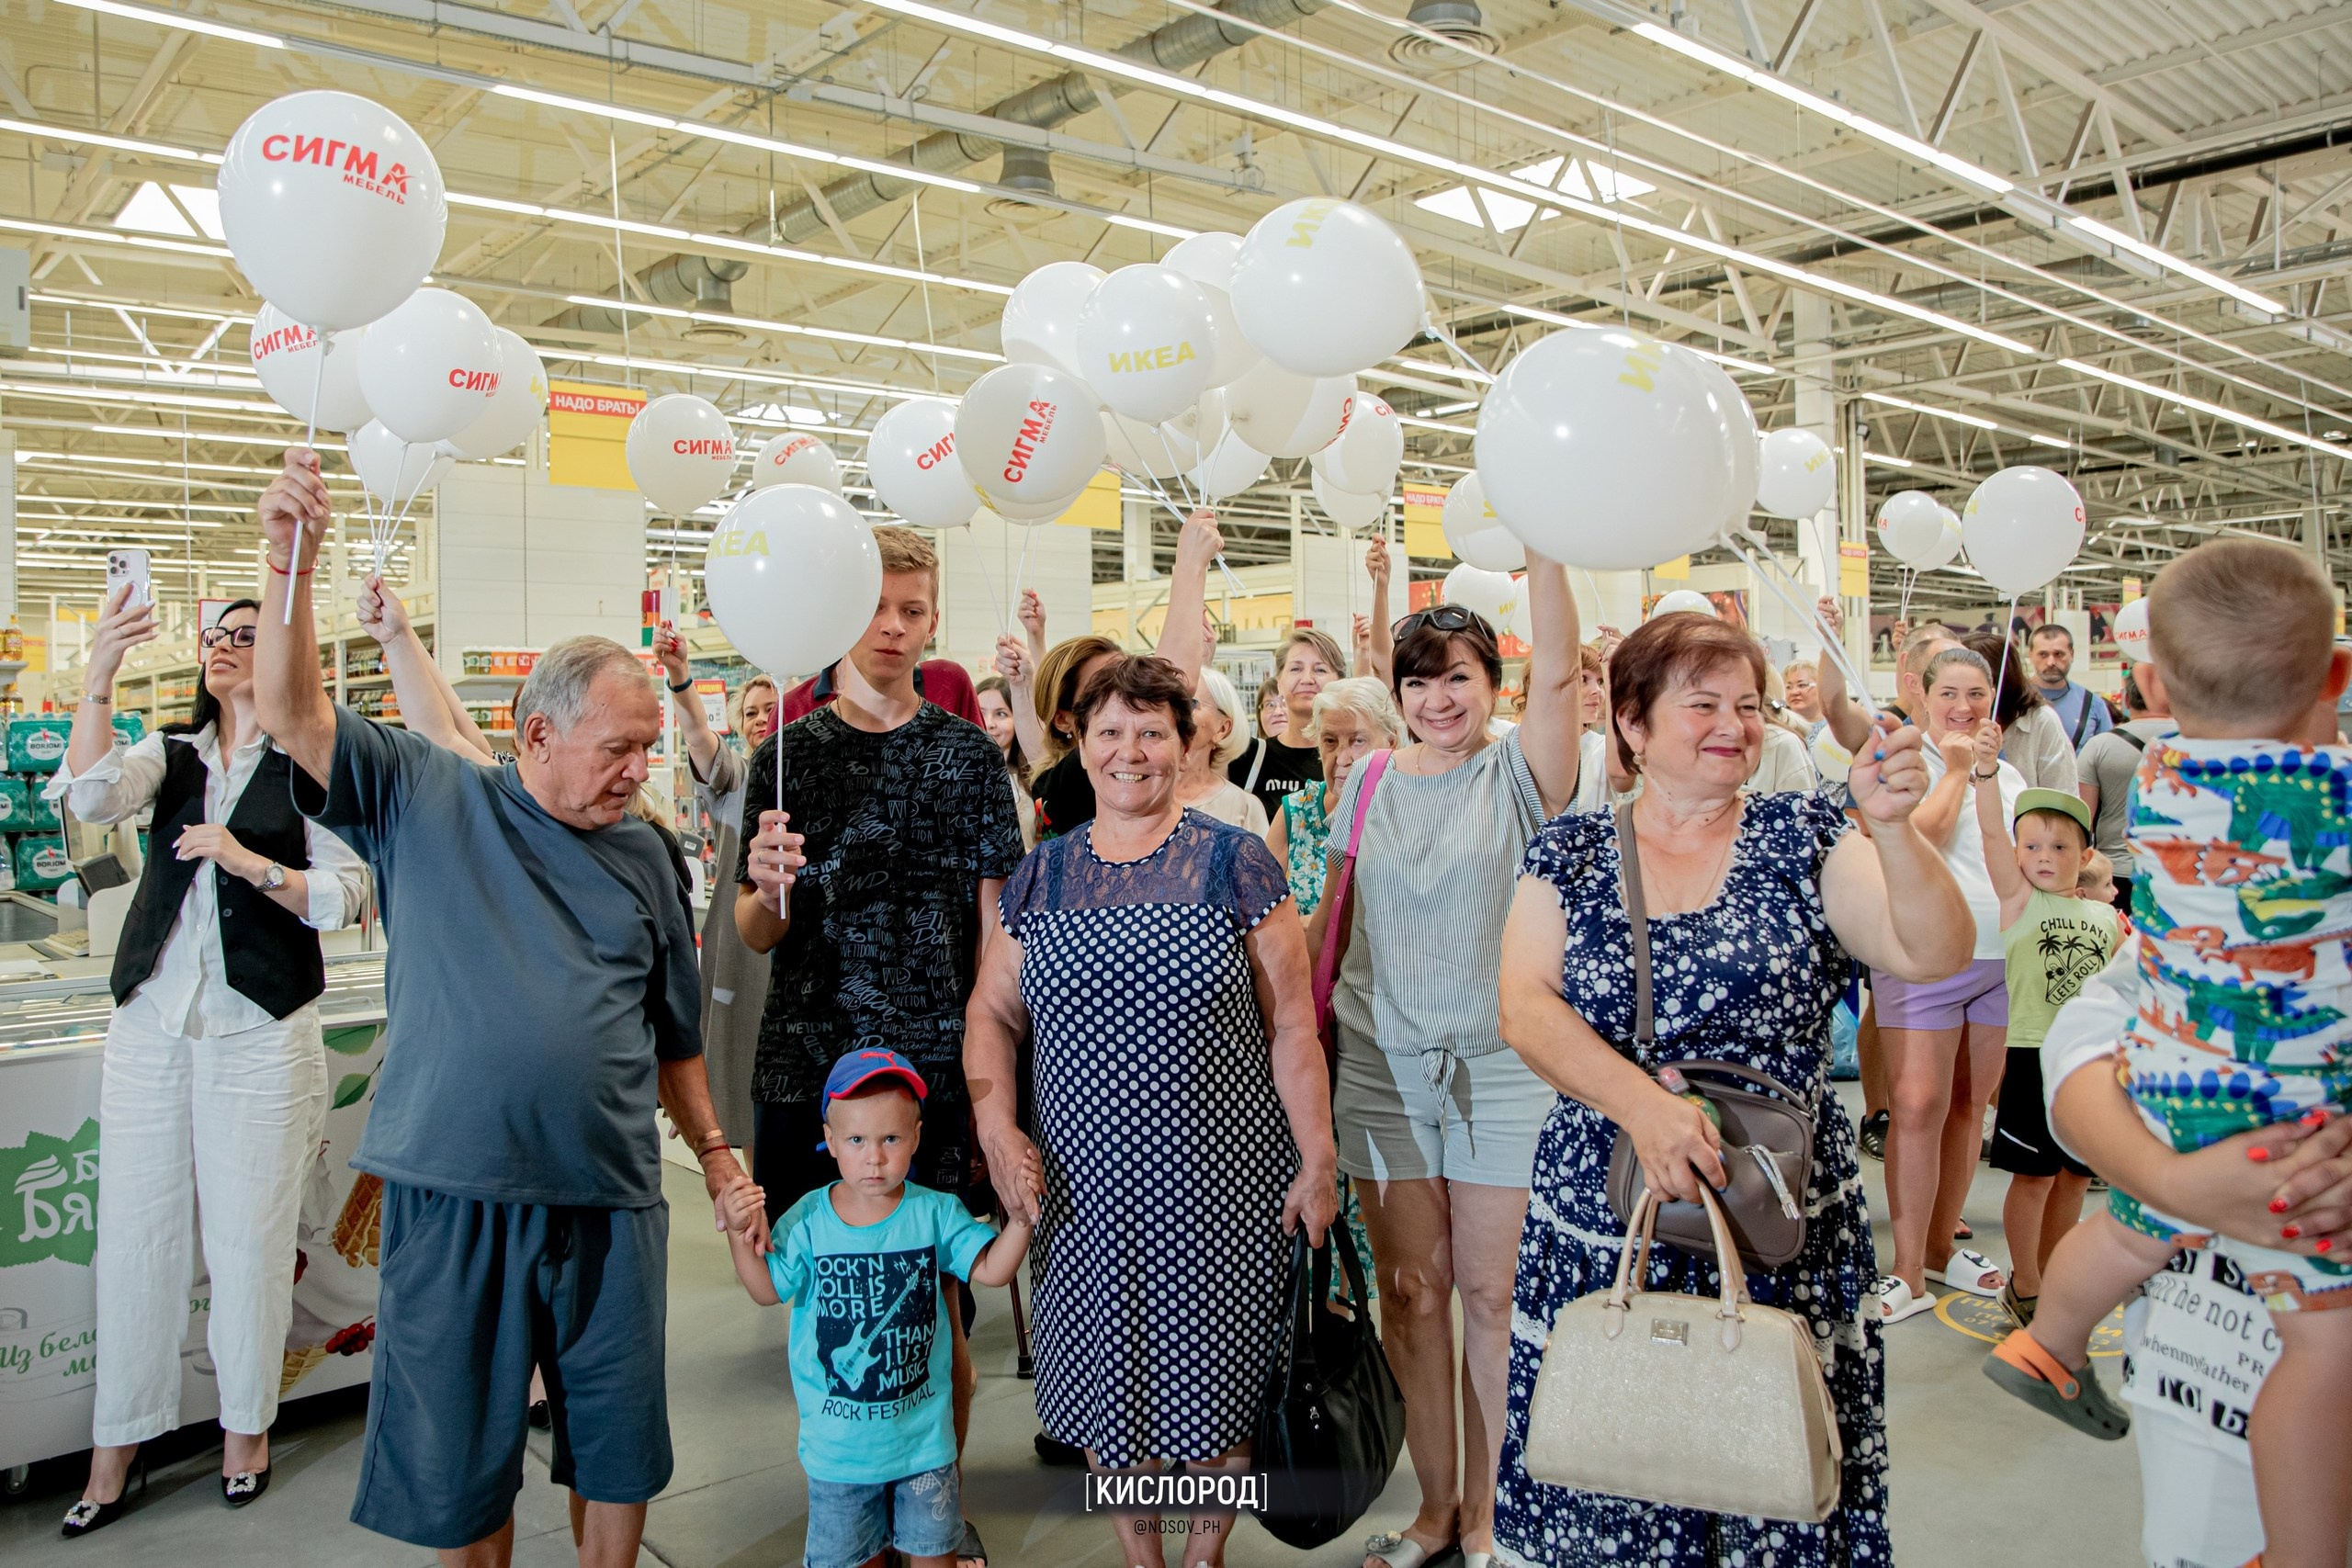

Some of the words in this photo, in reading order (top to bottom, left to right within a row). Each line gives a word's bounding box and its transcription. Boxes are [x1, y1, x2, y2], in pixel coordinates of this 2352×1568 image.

[262, 134, 416, 195] СИГМА
[343, 174, 405, 206] МЕБЕЛЬ
[288, 340, 318, 354] МЕБЕ
[1108, 341, 1196, 374] ИКЕА
[449, 368, 503, 391] СИГМ
[555, 396, 594, 412] НАДО
[597, 400, 640, 415] БРАТЬ!
[1003, 394, 1050, 483] СИГМА
[1039, 404, 1057, 444] МЕБЕЛЬ
[673, 439, 732, 455] СИГМА
[916, 432, 956, 470] СИГ
[706, 530, 771, 559] КЕА
[2041, 918, 2075, 932] CHILL
[2081, 920, 2108, 943] DAYS
[2074, 959, 2097, 981] ROLL
[814, 1254, 885, 1277] OCK`N
[868, 1274, 886, 1298] IS
[817, 1295, 885, 1320] MORE
[2204, 1301, 2253, 1340] not
[881, 1320, 934, 1348] THAN
[0, 1344, 32, 1374] Из
[886, 1338, 933, 1371] JUST
[876, 1358, 927, 1393] MUSIC
[821, 1399, 862, 1421] ROCK
[867, 1382, 936, 1421] FESTIVAL
